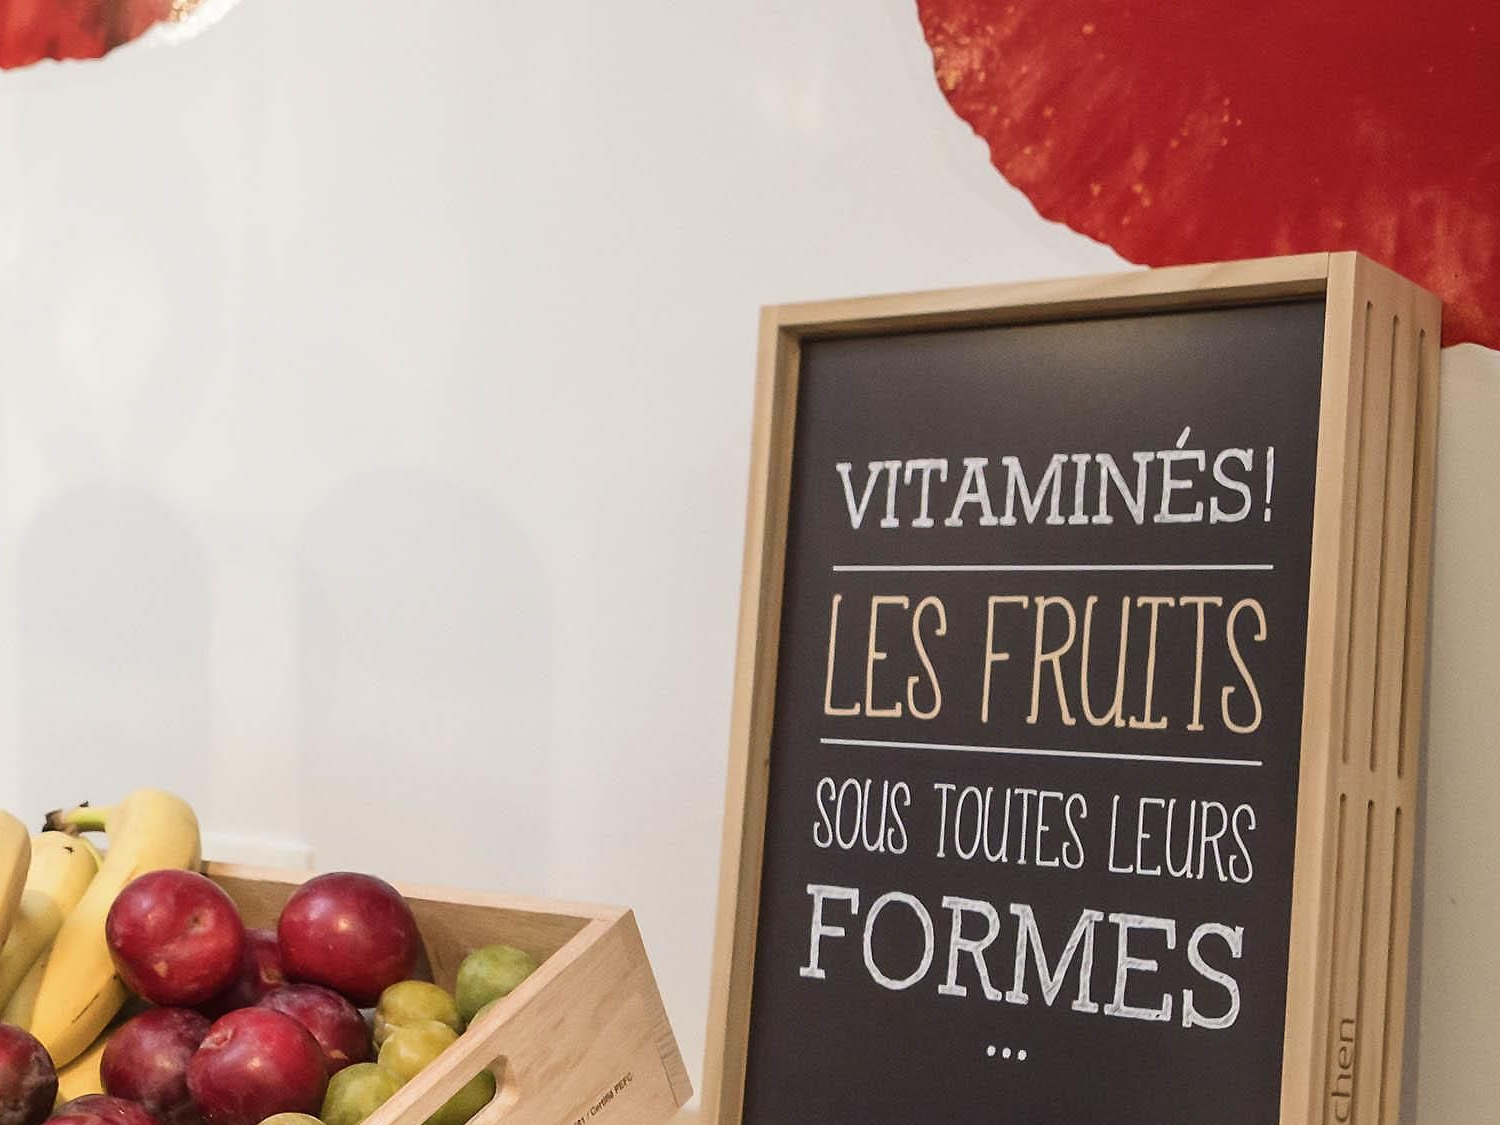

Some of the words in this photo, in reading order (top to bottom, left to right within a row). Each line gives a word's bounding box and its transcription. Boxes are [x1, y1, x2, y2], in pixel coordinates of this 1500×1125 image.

[835, 425, 1275, 530] VITAMINÉS!
[823, 593, 947, 720] LES
[981, 595, 1267, 734] FRUITS
[812, 776, 911, 855] SOUS
[933, 782, 1088, 870] TOUTES
[1108, 794, 1257, 884] LEURS
[799, 884, 1244, 1030] FORMES
